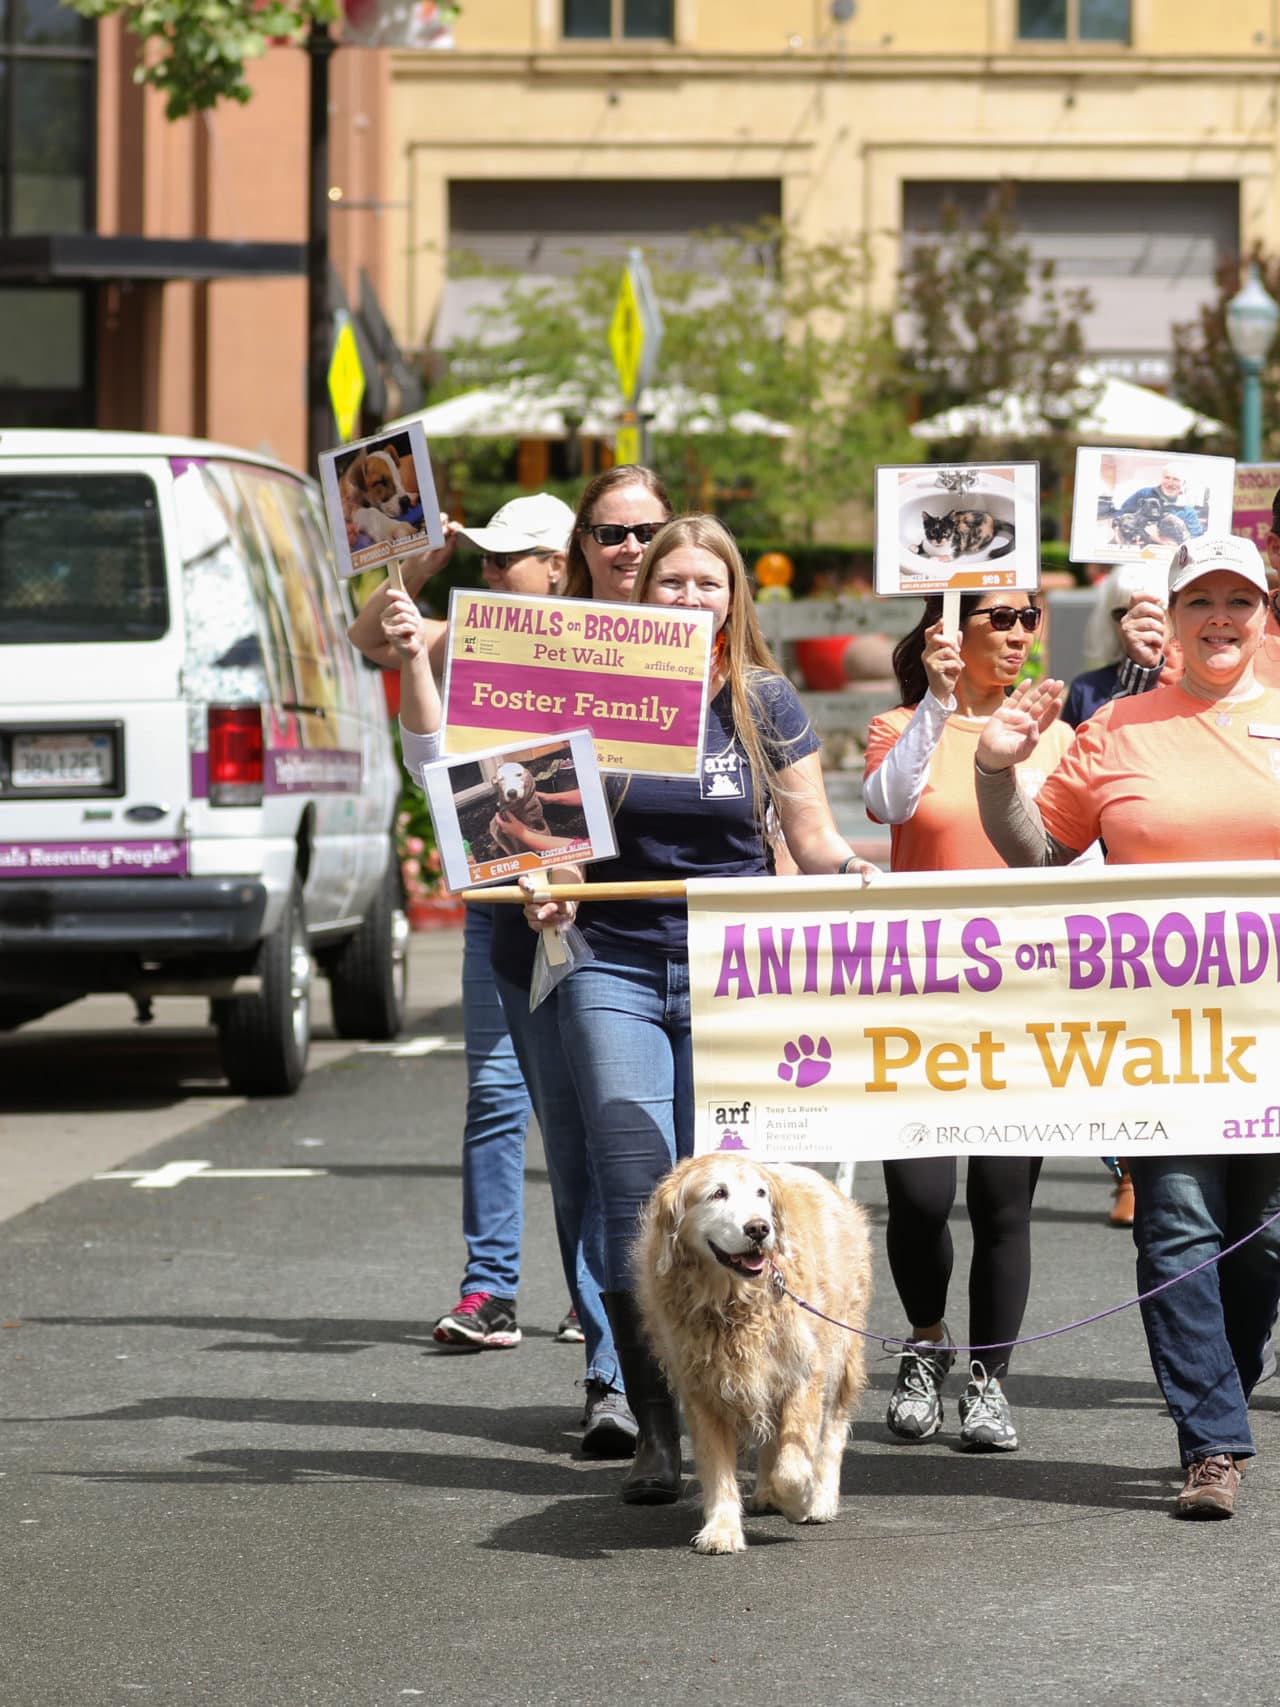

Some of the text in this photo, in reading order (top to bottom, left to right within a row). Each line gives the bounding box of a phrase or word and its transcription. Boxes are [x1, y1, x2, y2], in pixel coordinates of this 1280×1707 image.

[464, 602, 698, 649] ANIMALS on BROADWAY
[533, 643, 625, 668] Pet Walk
[644, 661, 695, 676] arflife.org
[471, 682, 680, 731] Foster Family
[607, 753, 623, 764] Pet
[704, 753, 737, 773] arf
[714, 917, 1004, 1000] ANIMALS
[1015, 942, 1058, 971] on
[863, 1007, 1257, 1093] Pet Walk
[715, 1101, 751, 1125] arf
[766, 1118, 808, 1129] Animal
[936, 1120, 1169, 1144] BROADWAY PLAZA
